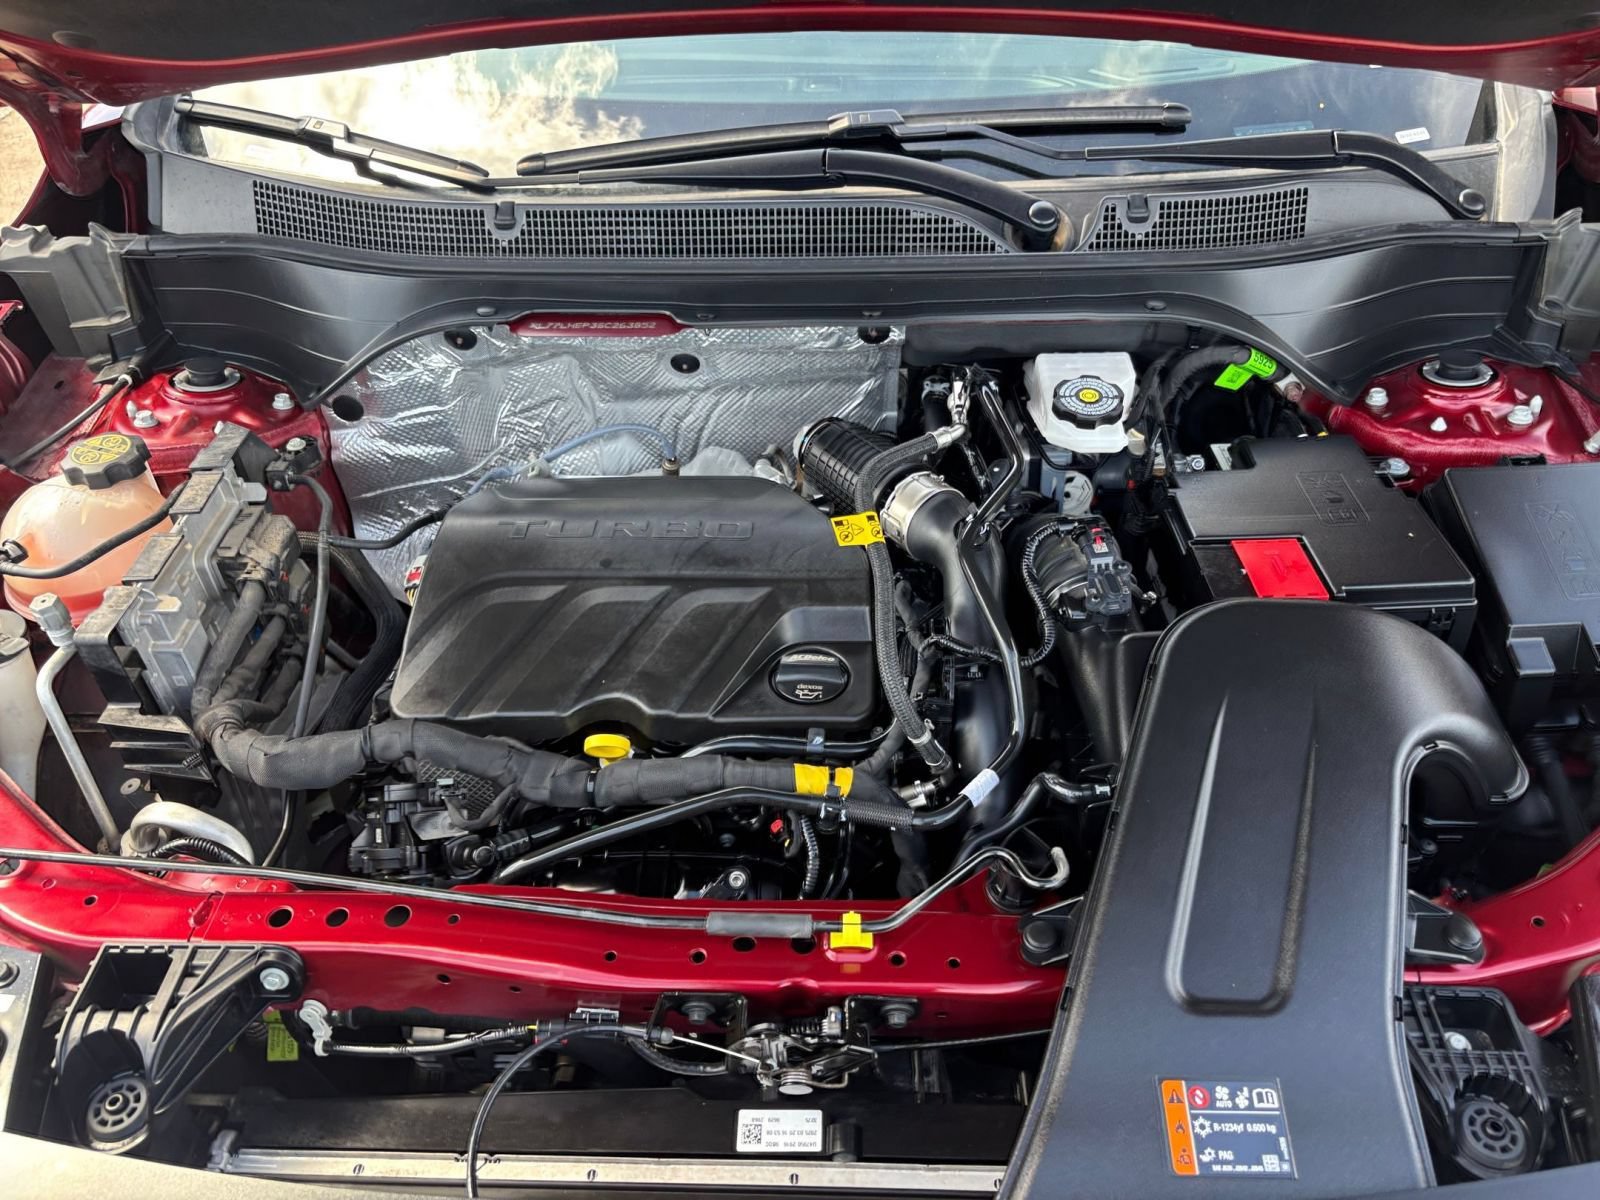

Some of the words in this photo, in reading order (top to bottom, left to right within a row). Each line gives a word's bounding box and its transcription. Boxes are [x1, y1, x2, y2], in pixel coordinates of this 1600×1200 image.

[498, 519, 754, 541] TURBO
[1213, 1123, 1244, 1134] R-1234yf
[1266, 1123, 1277, 1134] kg
[1218, 1150, 1234, 1160] PAG
